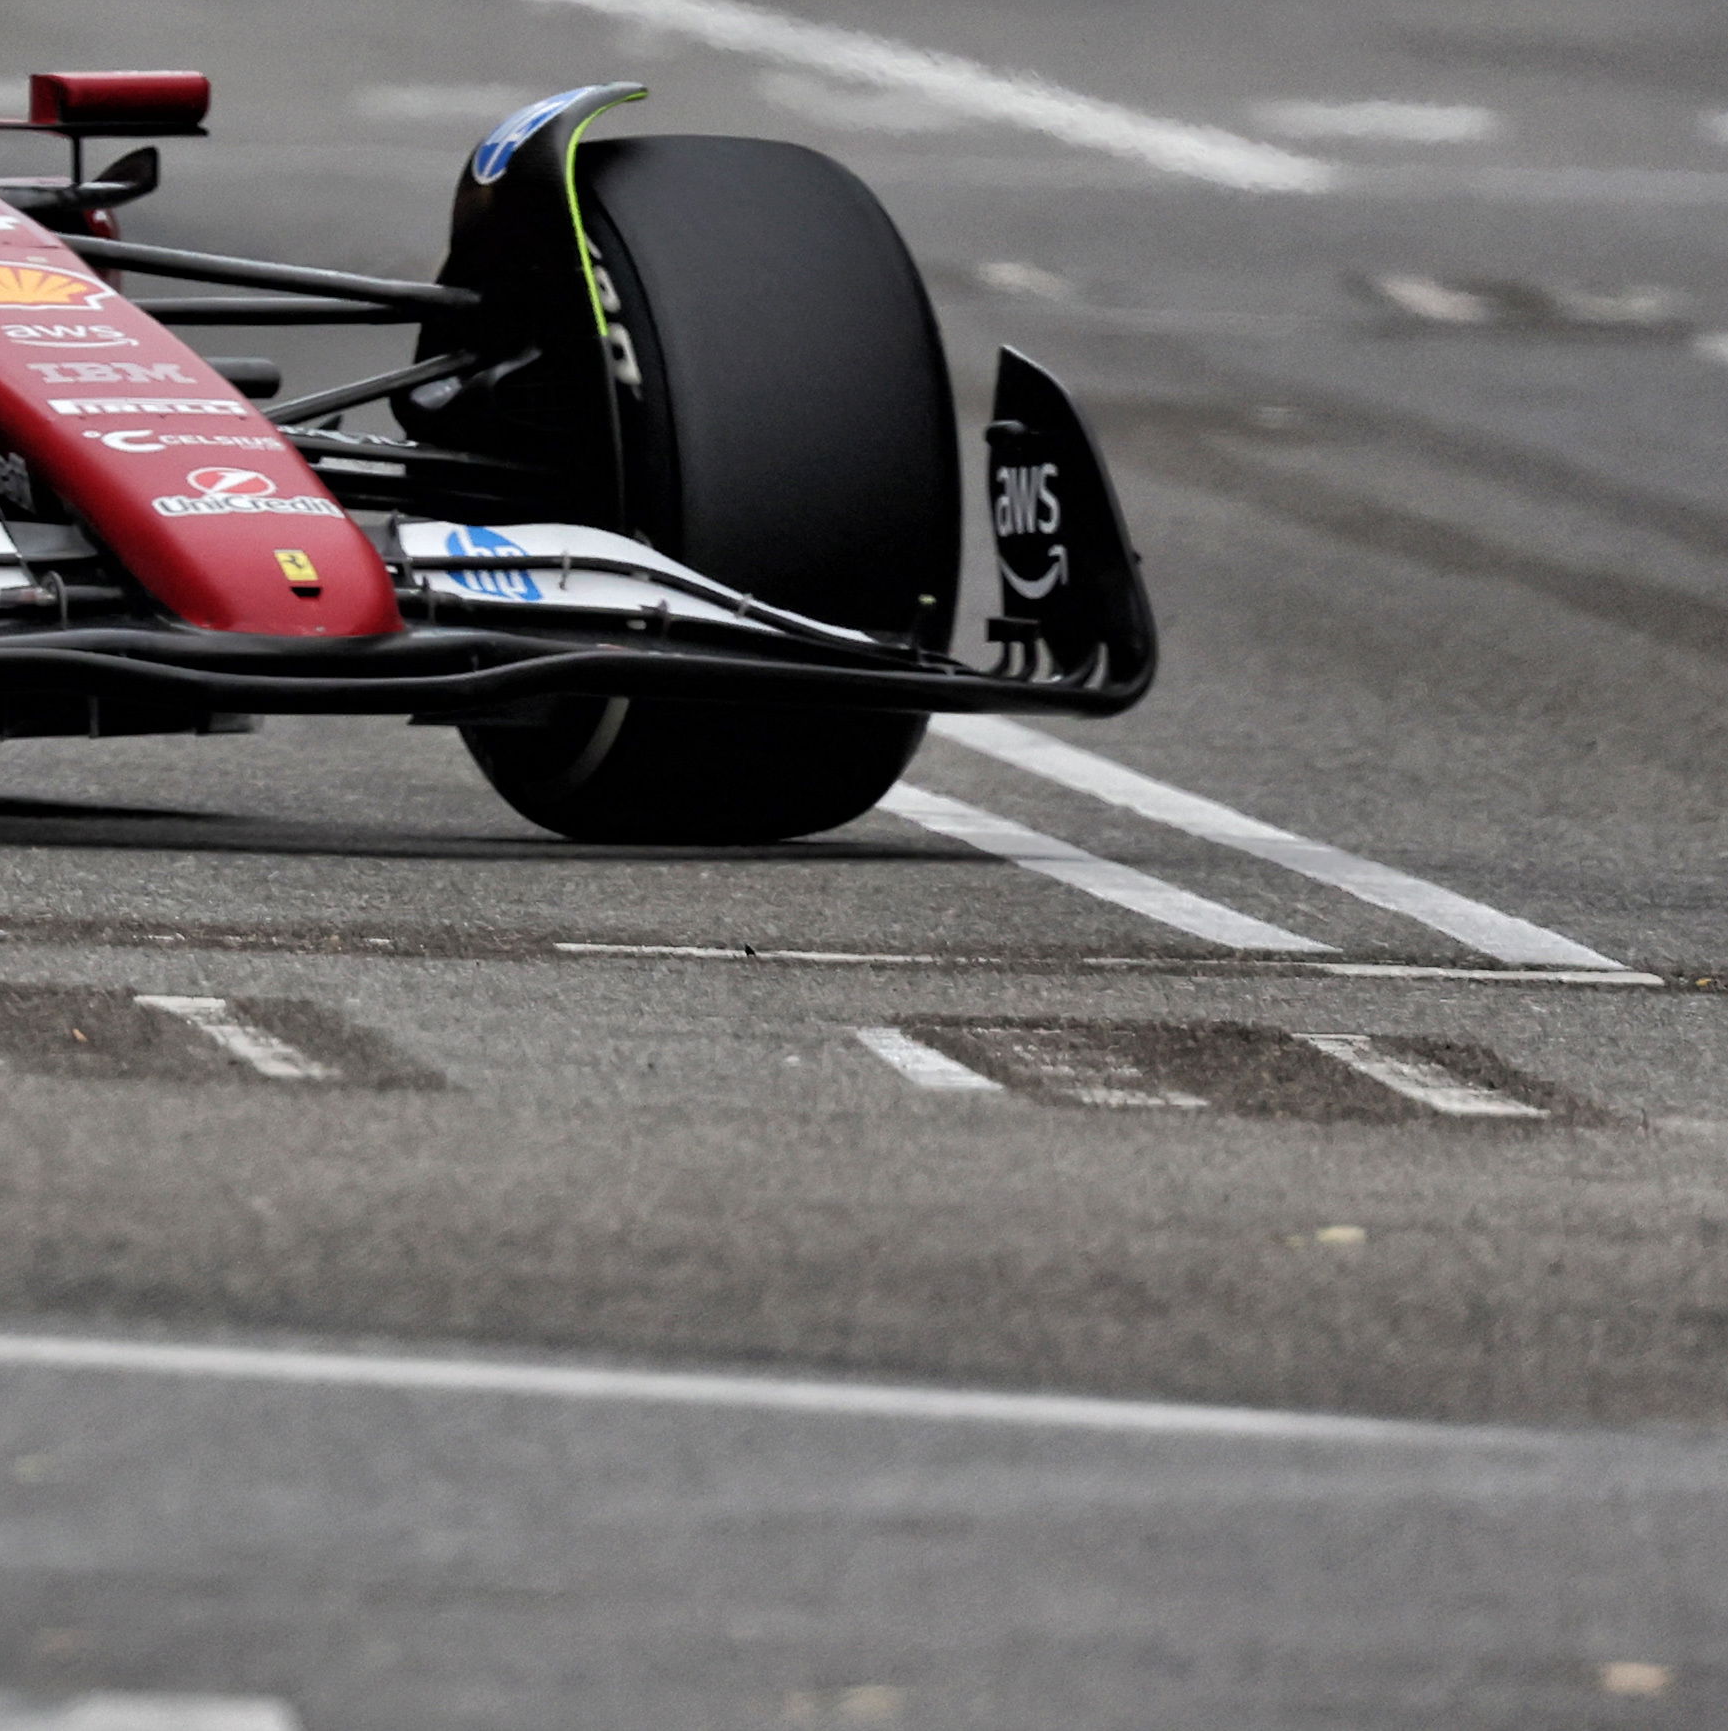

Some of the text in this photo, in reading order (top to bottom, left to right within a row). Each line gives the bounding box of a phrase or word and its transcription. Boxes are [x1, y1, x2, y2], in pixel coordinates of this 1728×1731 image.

[0, 324, 133, 343] aws
[26, 361, 198, 385] IBM
[47, 397, 248, 416] PIRELLI
[154, 496, 344, 517] UniCredit
[995, 462, 1062, 542] aws
